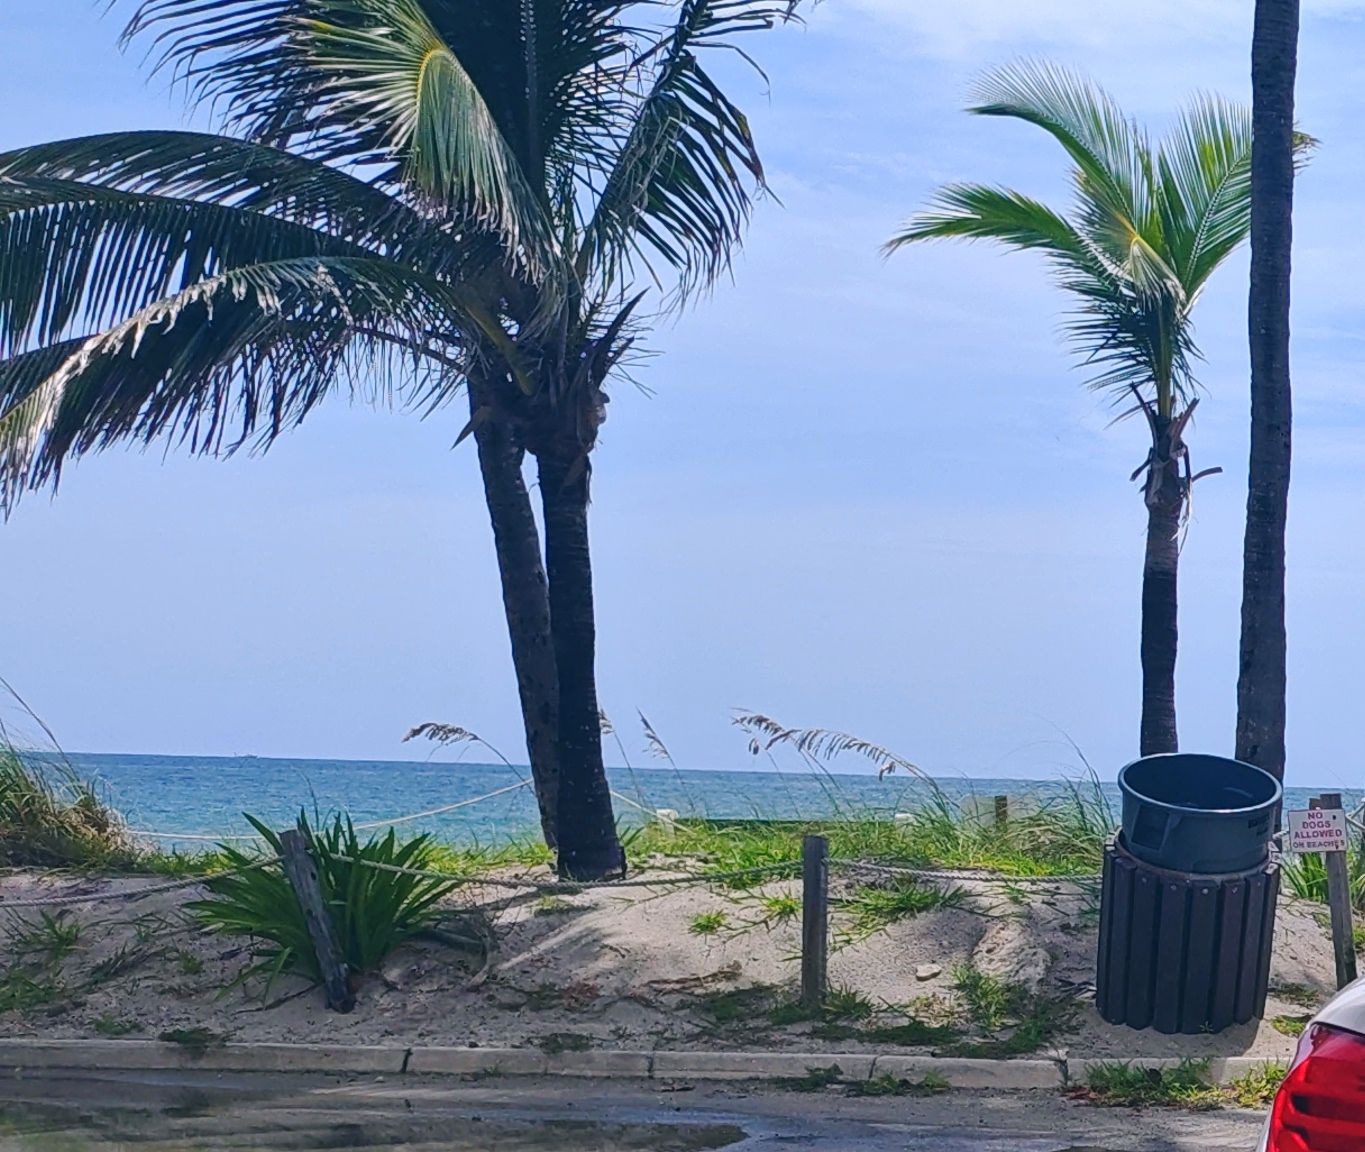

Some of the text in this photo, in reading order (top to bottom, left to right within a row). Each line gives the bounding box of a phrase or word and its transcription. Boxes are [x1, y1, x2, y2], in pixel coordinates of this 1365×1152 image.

[1308, 812, 1323, 820] NO
[1302, 821, 1331, 829] DOGS
[1294, 829, 1342, 839] ALLOWED
